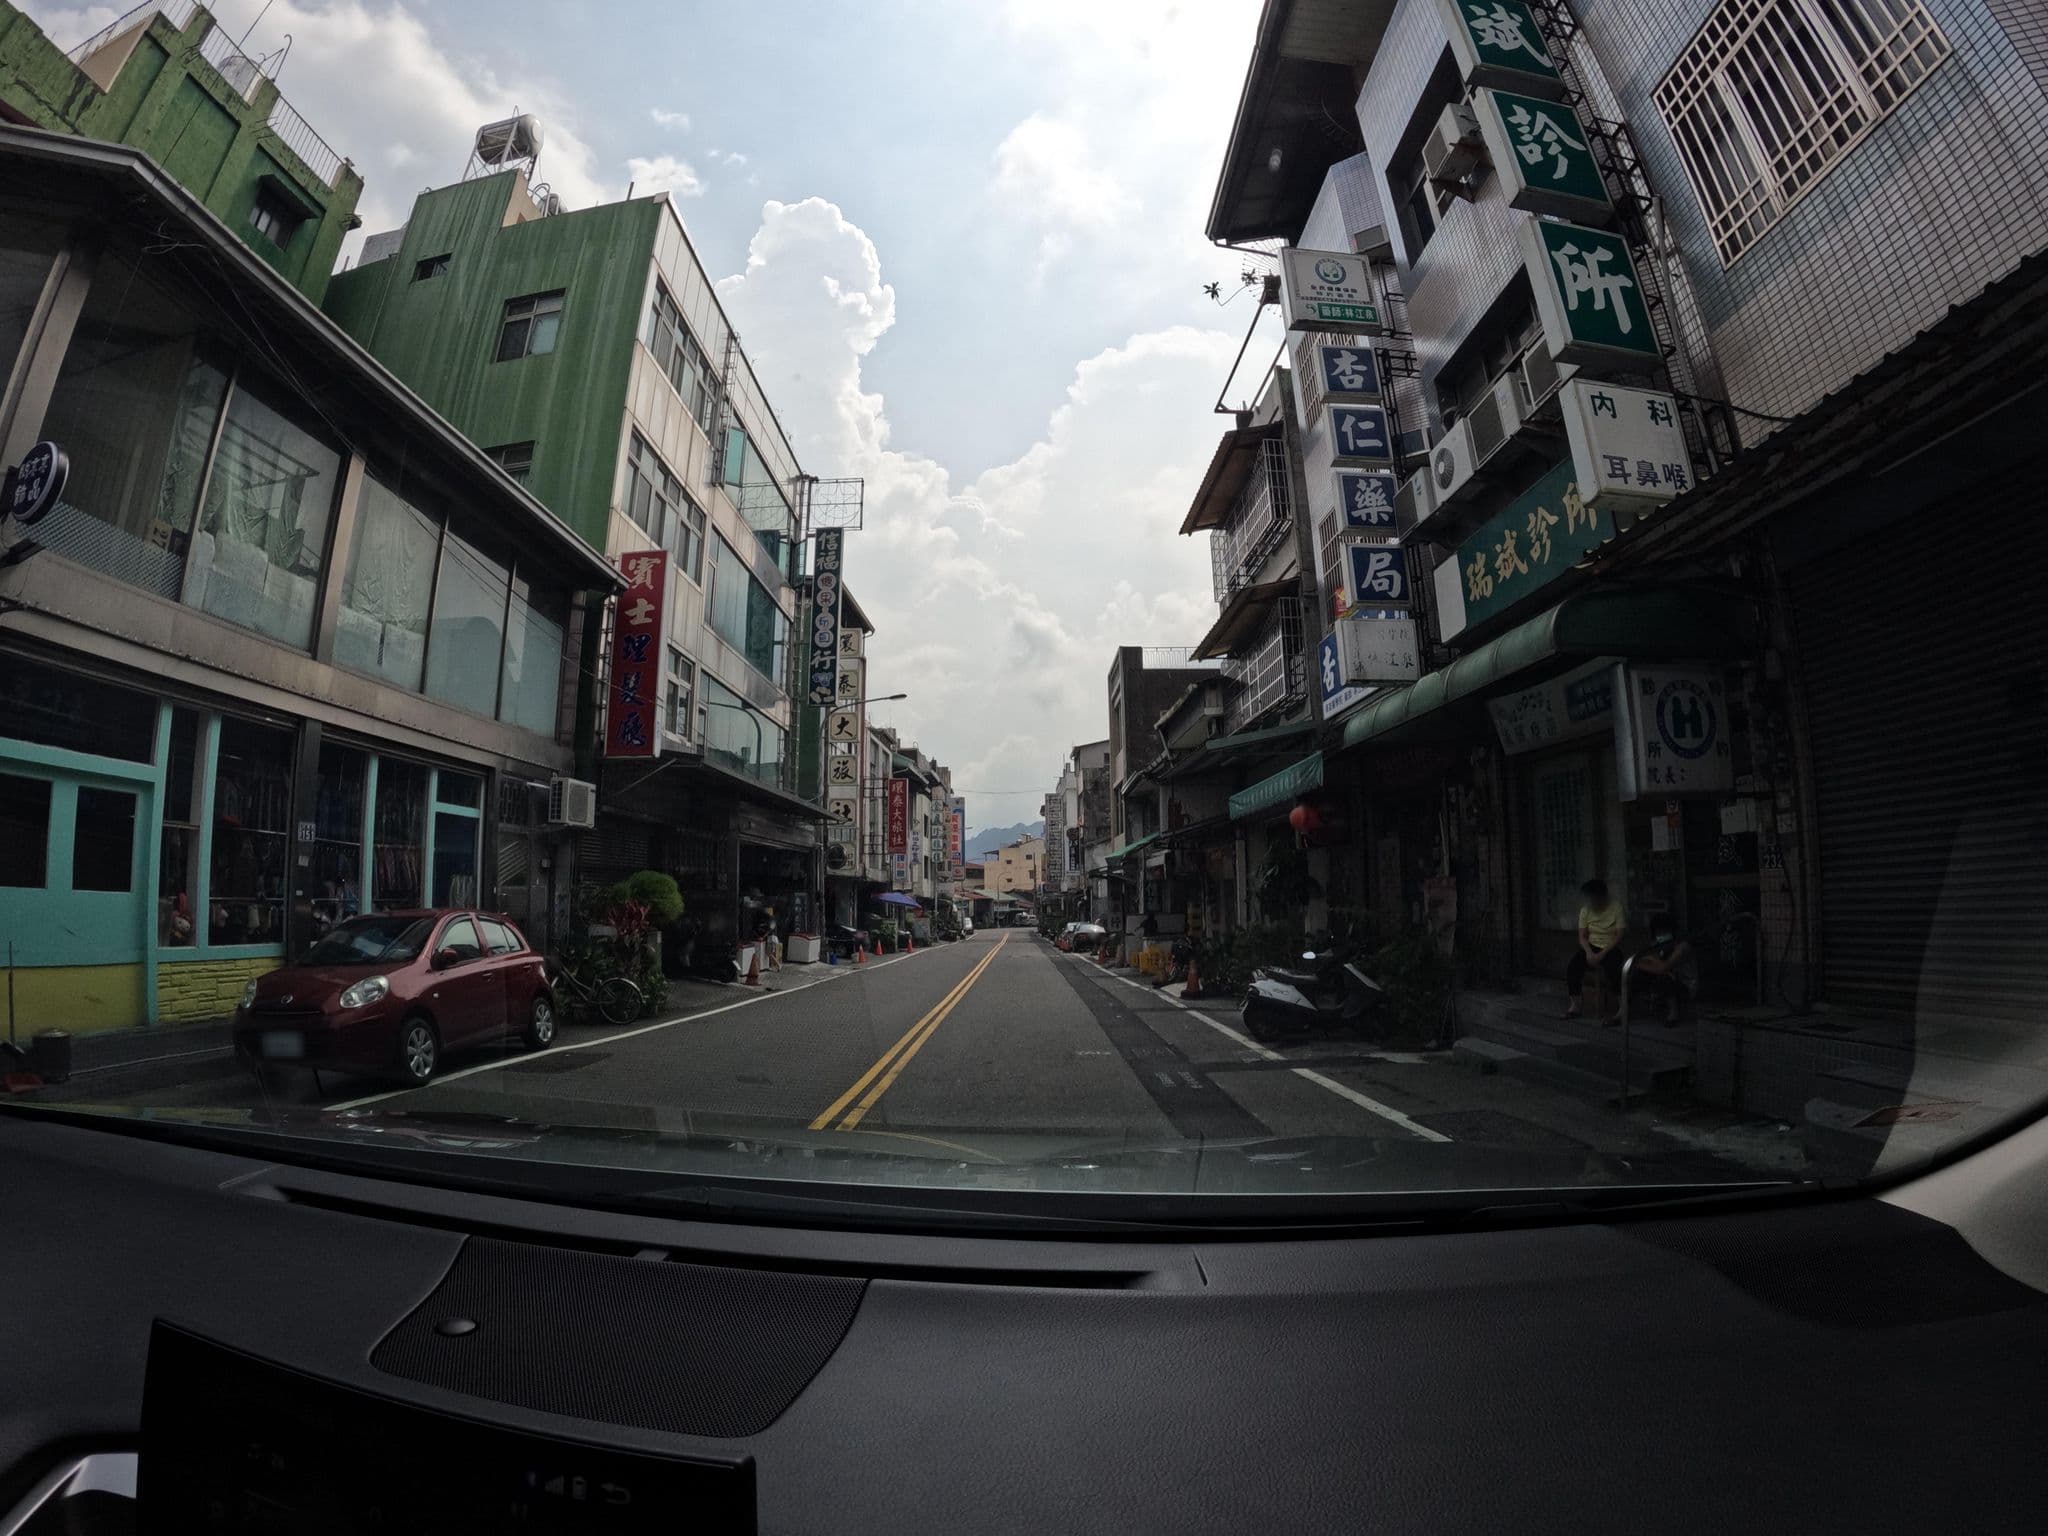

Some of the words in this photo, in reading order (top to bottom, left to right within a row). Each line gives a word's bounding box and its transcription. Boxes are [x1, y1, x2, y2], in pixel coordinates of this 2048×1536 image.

[1330, 350, 1402, 599] 杏仁藥局
[1602, 454, 1689, 490] 耳鼻喉
